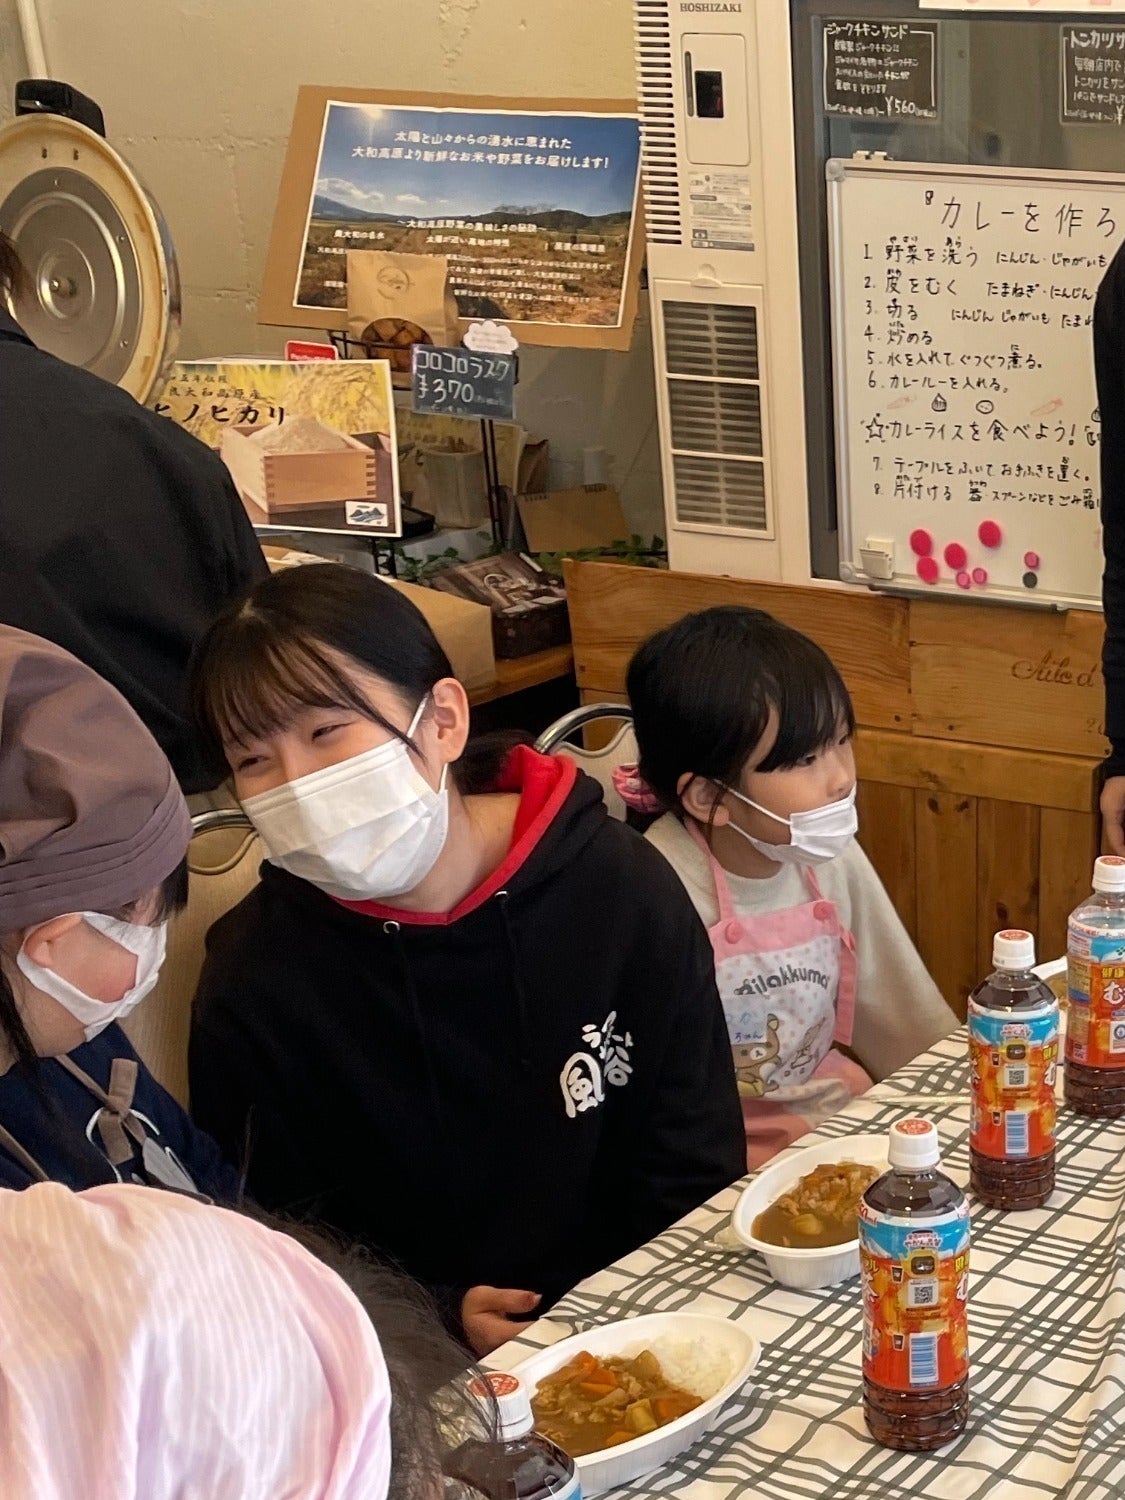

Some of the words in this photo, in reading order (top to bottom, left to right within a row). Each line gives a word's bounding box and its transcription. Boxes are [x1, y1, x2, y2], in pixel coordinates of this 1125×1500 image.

[680, 3, 742, 13] HOSHIZAKI
[885, 96, 916, 117] ¥560
[951, 309, 994, 322] にんじん
[417, 350, 510, 382] コロコロラスク
[417, 374, 475, 403] ¥370
[154, 403, 284, 425] ヒノヒカリ
